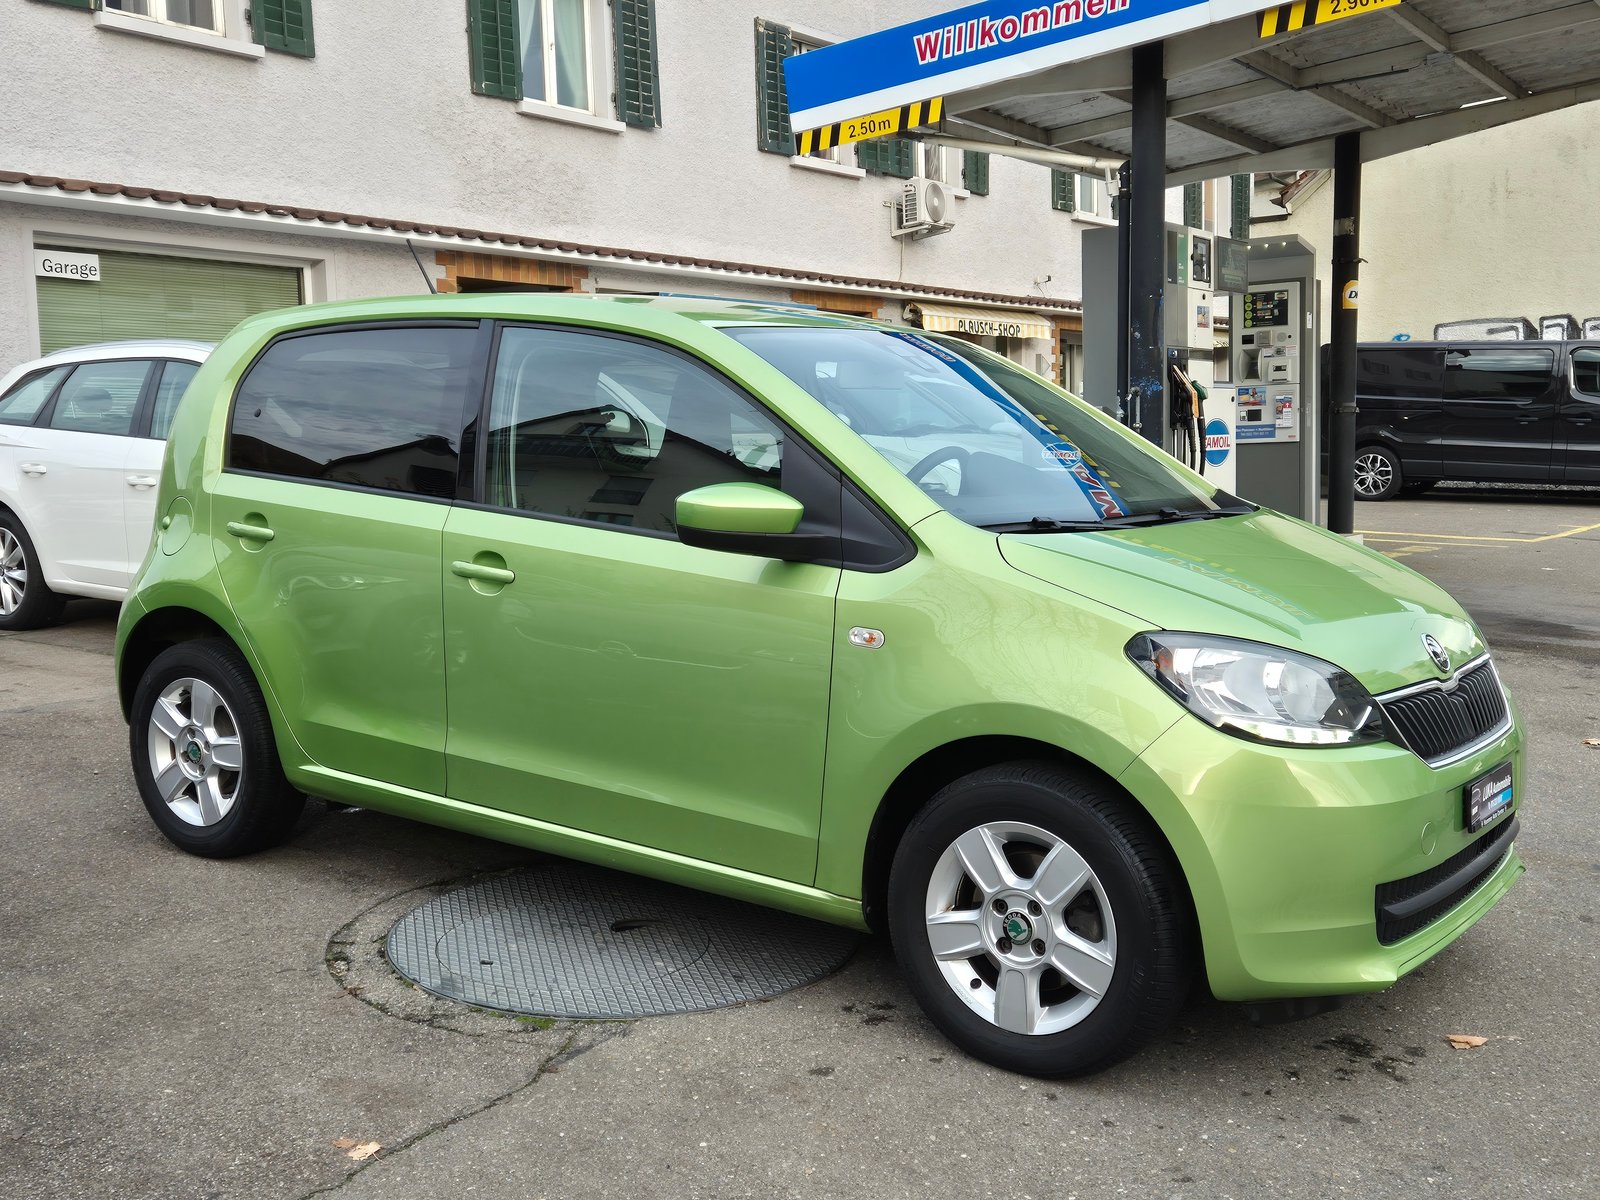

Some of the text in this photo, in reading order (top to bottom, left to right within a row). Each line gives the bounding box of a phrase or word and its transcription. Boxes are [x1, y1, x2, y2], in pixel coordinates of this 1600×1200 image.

[1330, 0, 1386, 14] 2.9
[42, 258, 98, 279] Garage
[958, 319, 1021, 338] PLAUSCH-SHOP
